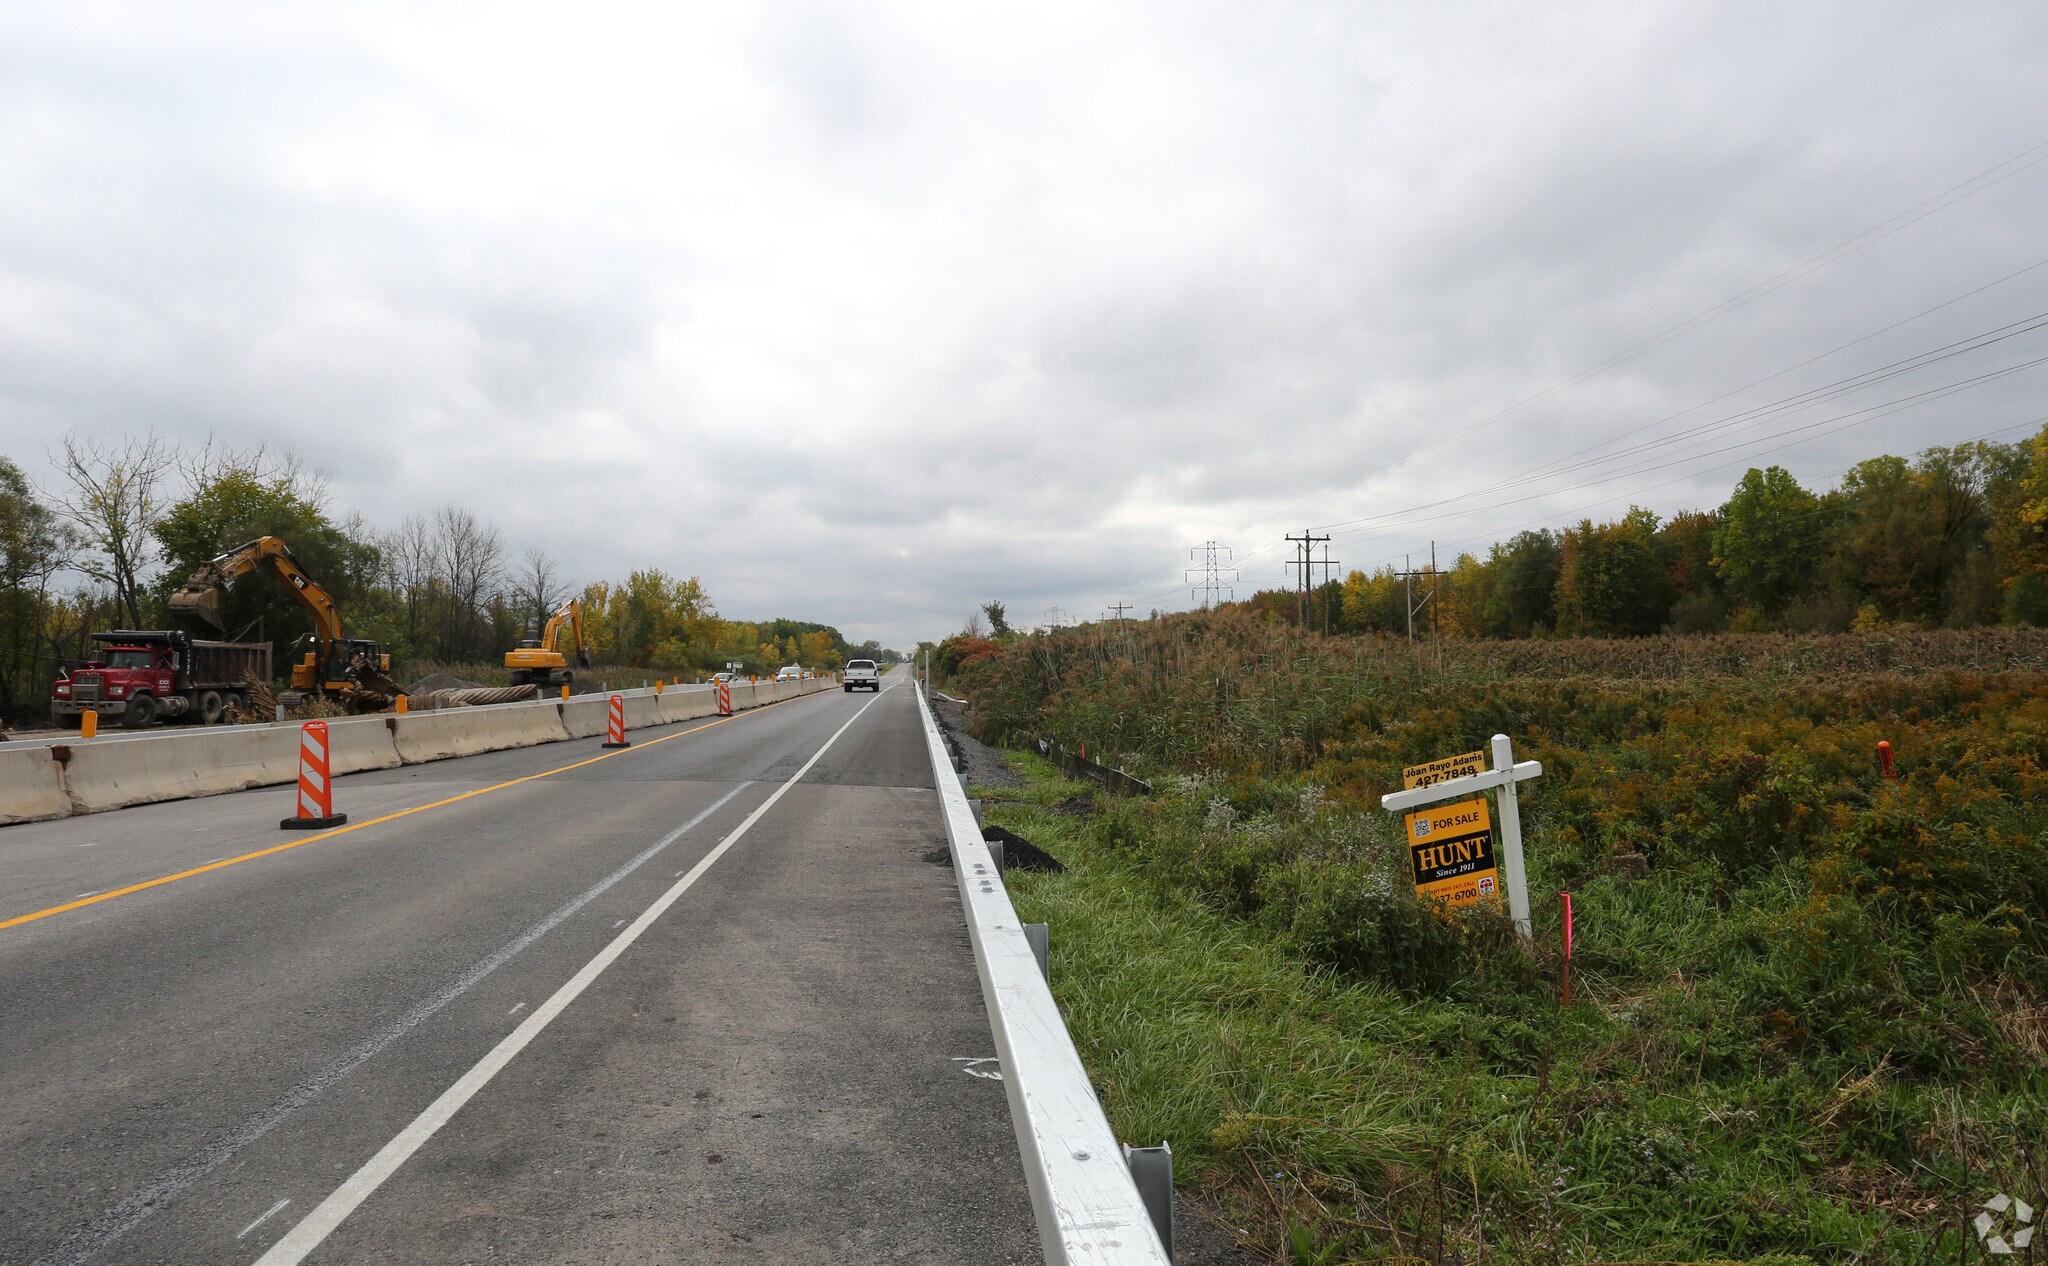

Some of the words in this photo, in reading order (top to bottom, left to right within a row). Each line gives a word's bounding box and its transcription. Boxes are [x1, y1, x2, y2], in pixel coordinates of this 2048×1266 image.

[1405, 767, 1427, 778] Joan
[1429, 762, 1451, 773] Rayo
[1453, 754, 1483, 767] Adams
[1415, 765, 1476, 787] 427-7848
[1433, 817, 1453, 830] FOR
[1455, 811, 1479, 826] SALE
[1417, 836, 1486, 871] HUNT
[1436, 867, 1457, 878] Since
[1459, 862, 1475, 873] 1911
[1463, 880, 1476, 888] CALL
